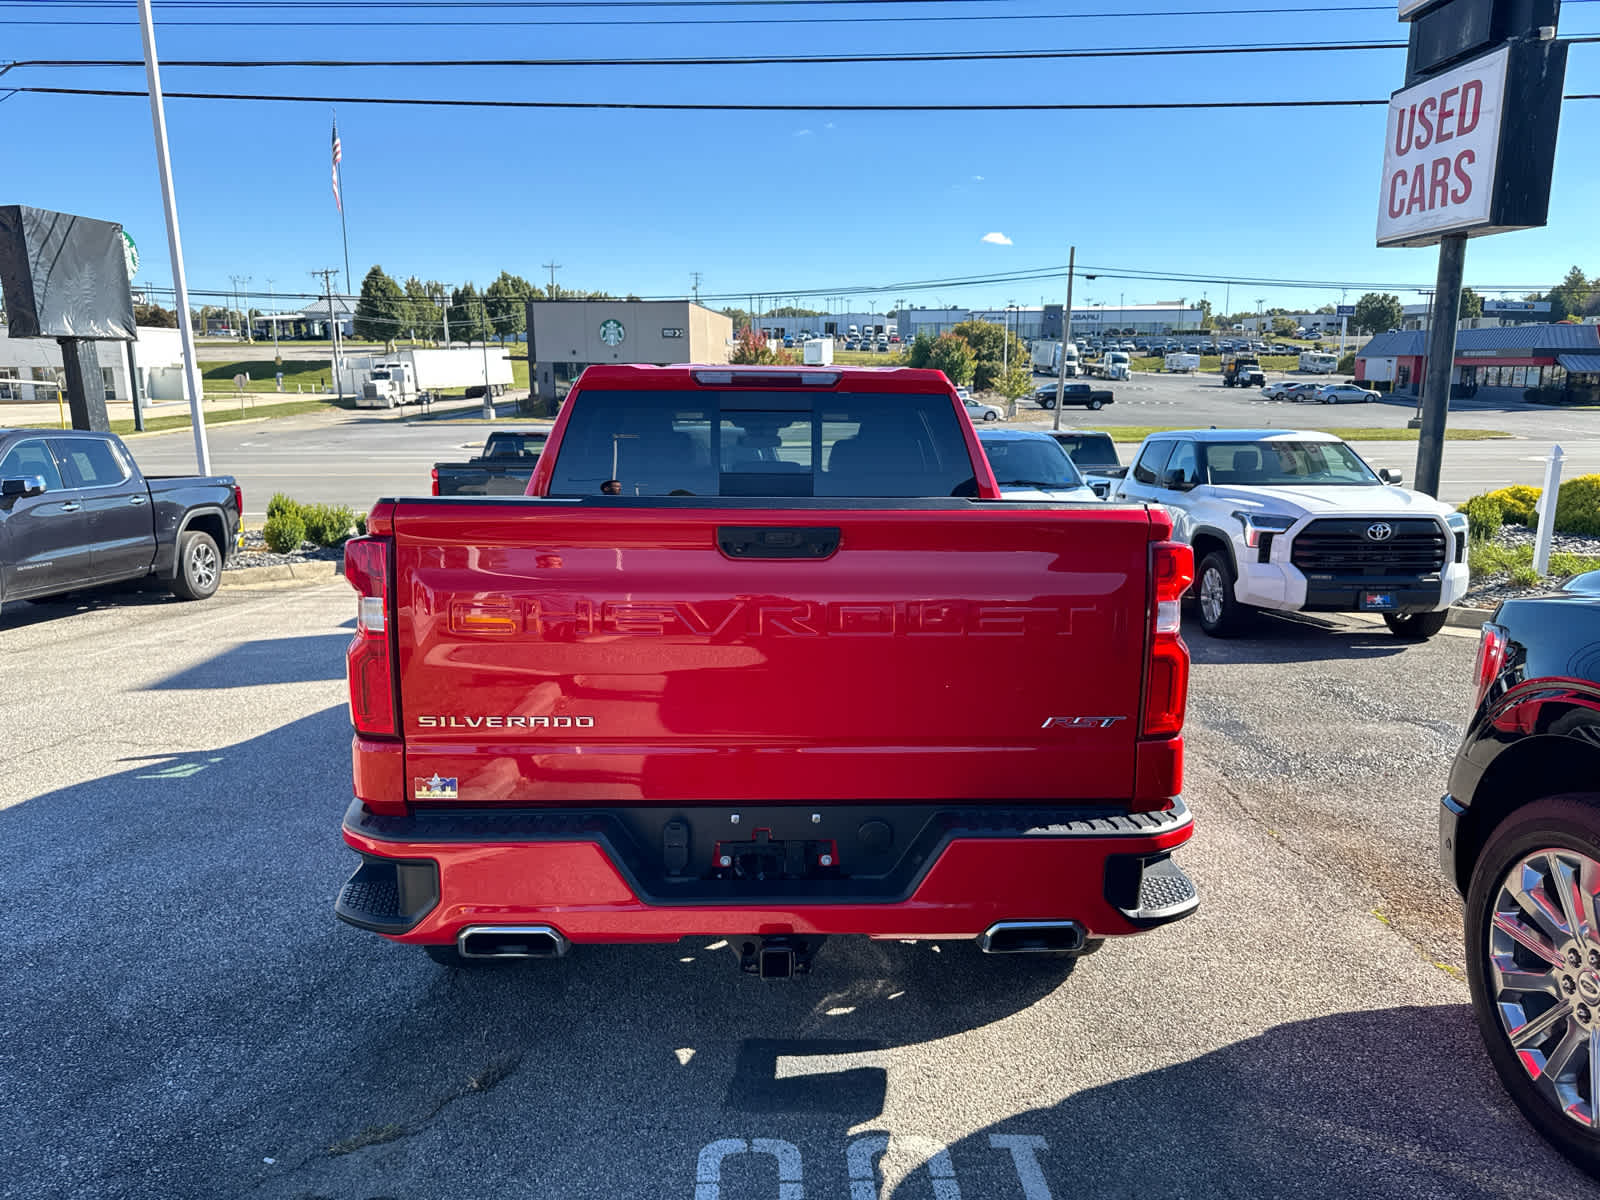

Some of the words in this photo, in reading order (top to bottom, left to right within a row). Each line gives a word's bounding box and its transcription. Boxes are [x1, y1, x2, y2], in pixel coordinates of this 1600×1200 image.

[1395, 79, 1483, 157] USED
[1388, 149, 1476, 219] CARS
[446, 599, 1098, 637] CHEVROLET
[417, 715, 595, 728] SILVERADO
[1041, 716, 1127, 728] RST
